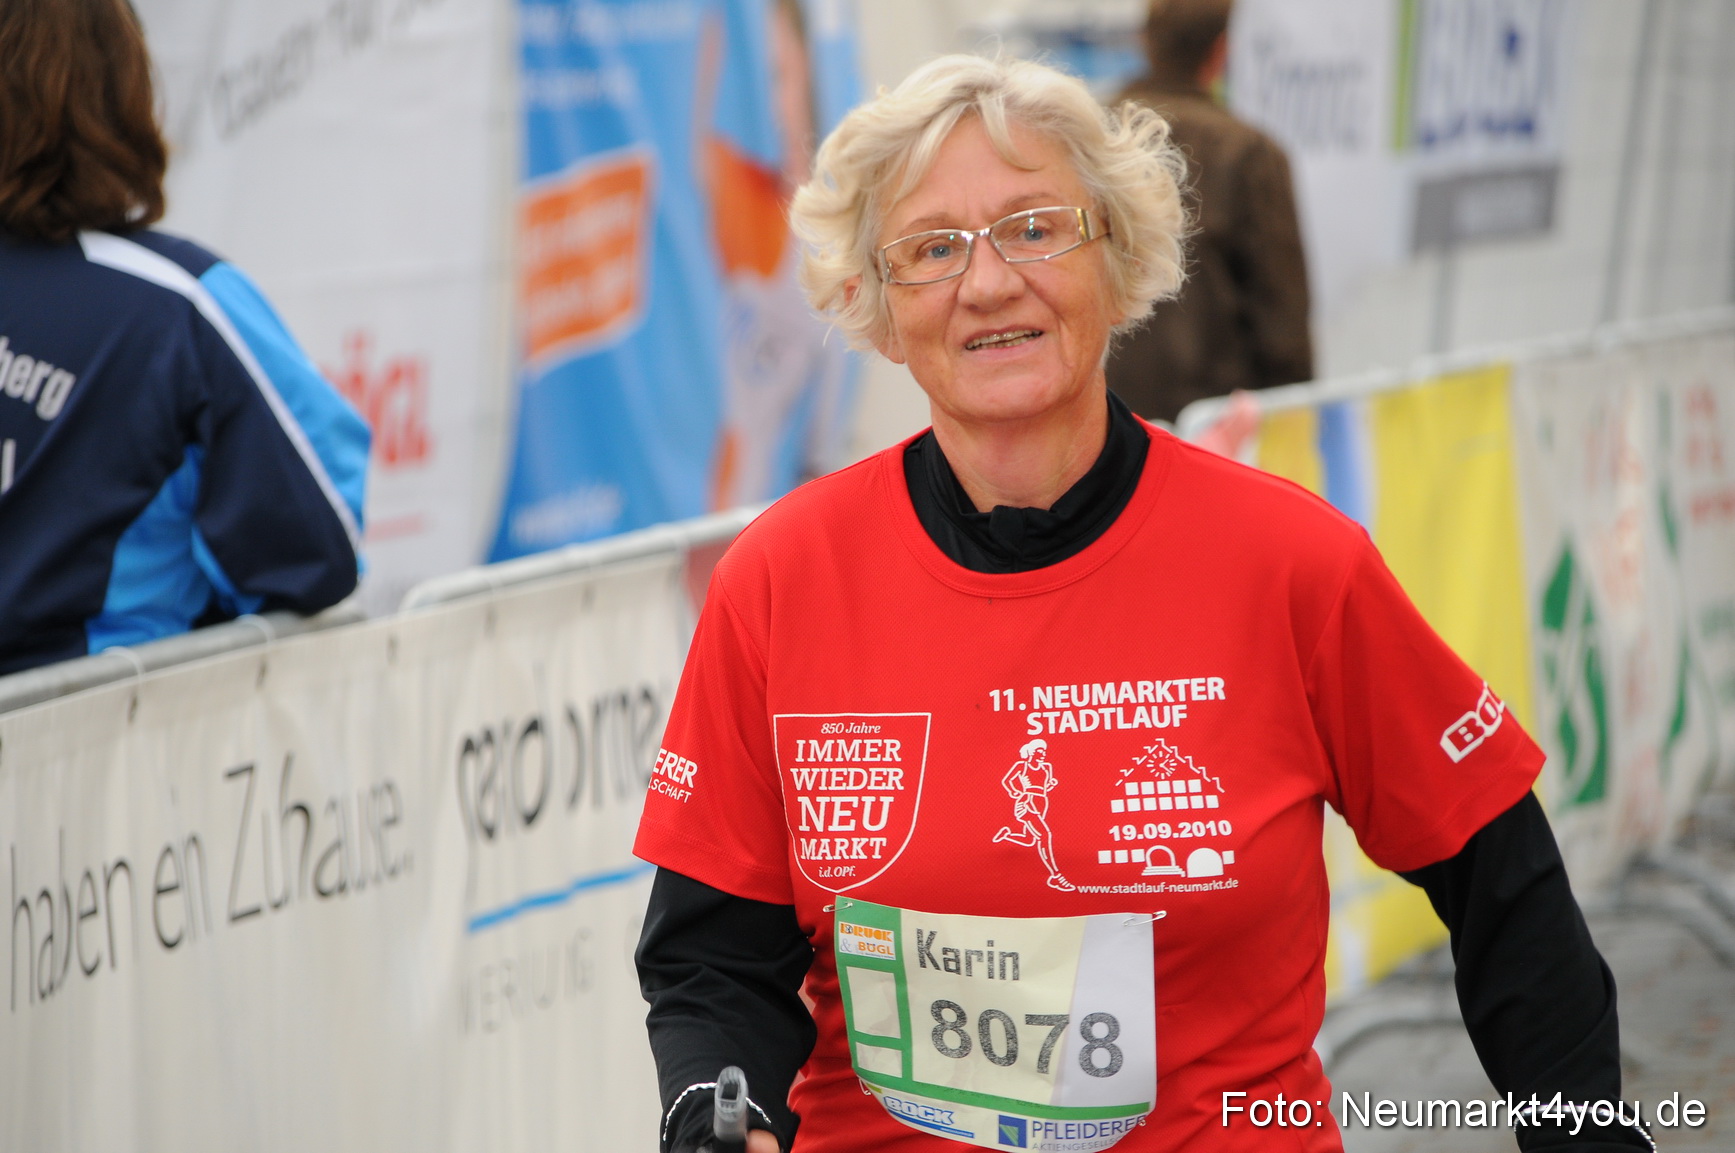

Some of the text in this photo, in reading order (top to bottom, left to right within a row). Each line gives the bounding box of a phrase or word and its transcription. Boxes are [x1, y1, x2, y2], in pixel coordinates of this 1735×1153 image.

[988, 677, 1226, 712] 11. NEUMARKTER
[820, 722, 881, 735] 850 Jahre
[1026, 704, 1188, 735] STADTLAUF
[795, 739, 902, 762] IMMER
[652, 748, 698, 789] ERER
[790, 767, 904, 791] WIEDER
[797, 796, 894, 832] NEU
[1108, 820, 1232, 841] 19.09.2010
[800, 837, 887, 860] MARKT
[1077, 878, 1239, 894] www.stadtlauf-neumarkt.de
[916, 928, 1020, 981] Karin
[931, 999, 1124, 1078] 8078
[884, 1096, 954, 1126] BOCK
